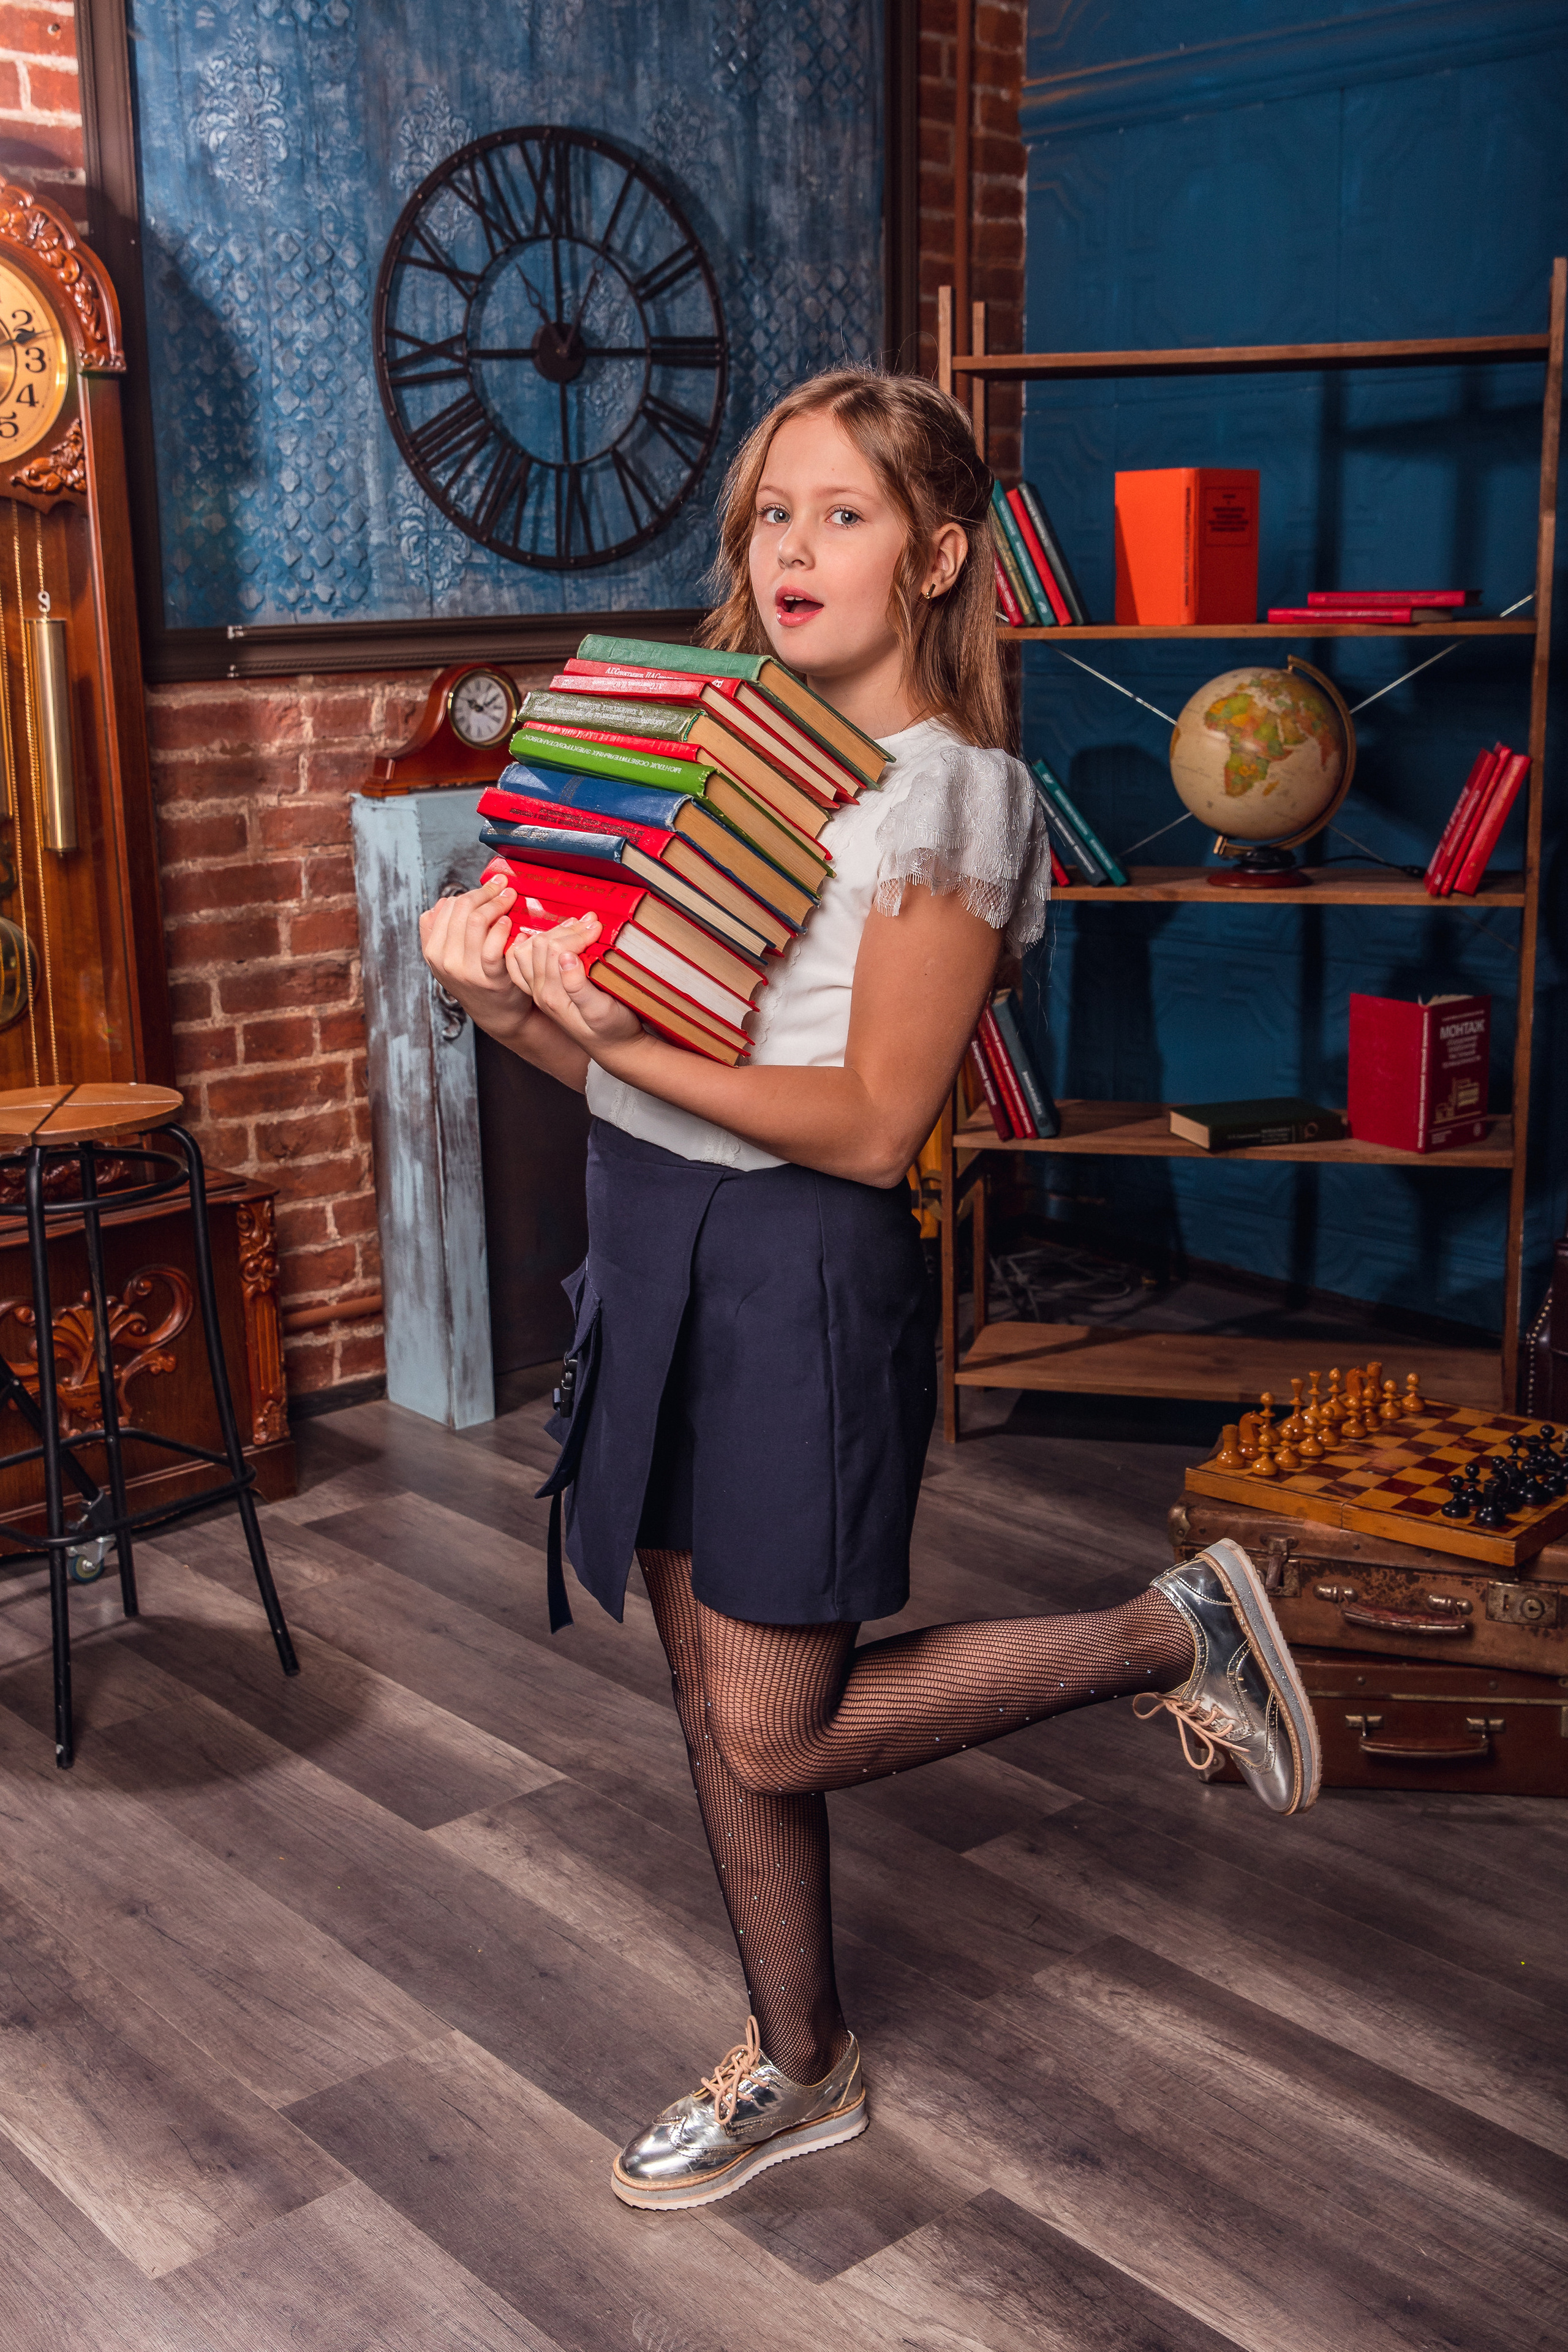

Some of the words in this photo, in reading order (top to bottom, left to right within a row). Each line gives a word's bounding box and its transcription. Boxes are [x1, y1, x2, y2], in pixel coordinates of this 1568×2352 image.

[12, 310, 35, 335] 2
[25, 347, 46, 373] 3
[16, 383, 39, 407] 4
[523, 734, 592, 756] ЭЛЕКТРОУСТАНОВОК
[591, 750, 650, 767] ОСВЕТИТЕЛЬНЫХ
[650, 761, 682, 774] МОНТАЖ
[1440, 1019, 1485, 1039] МОНТАЖ
